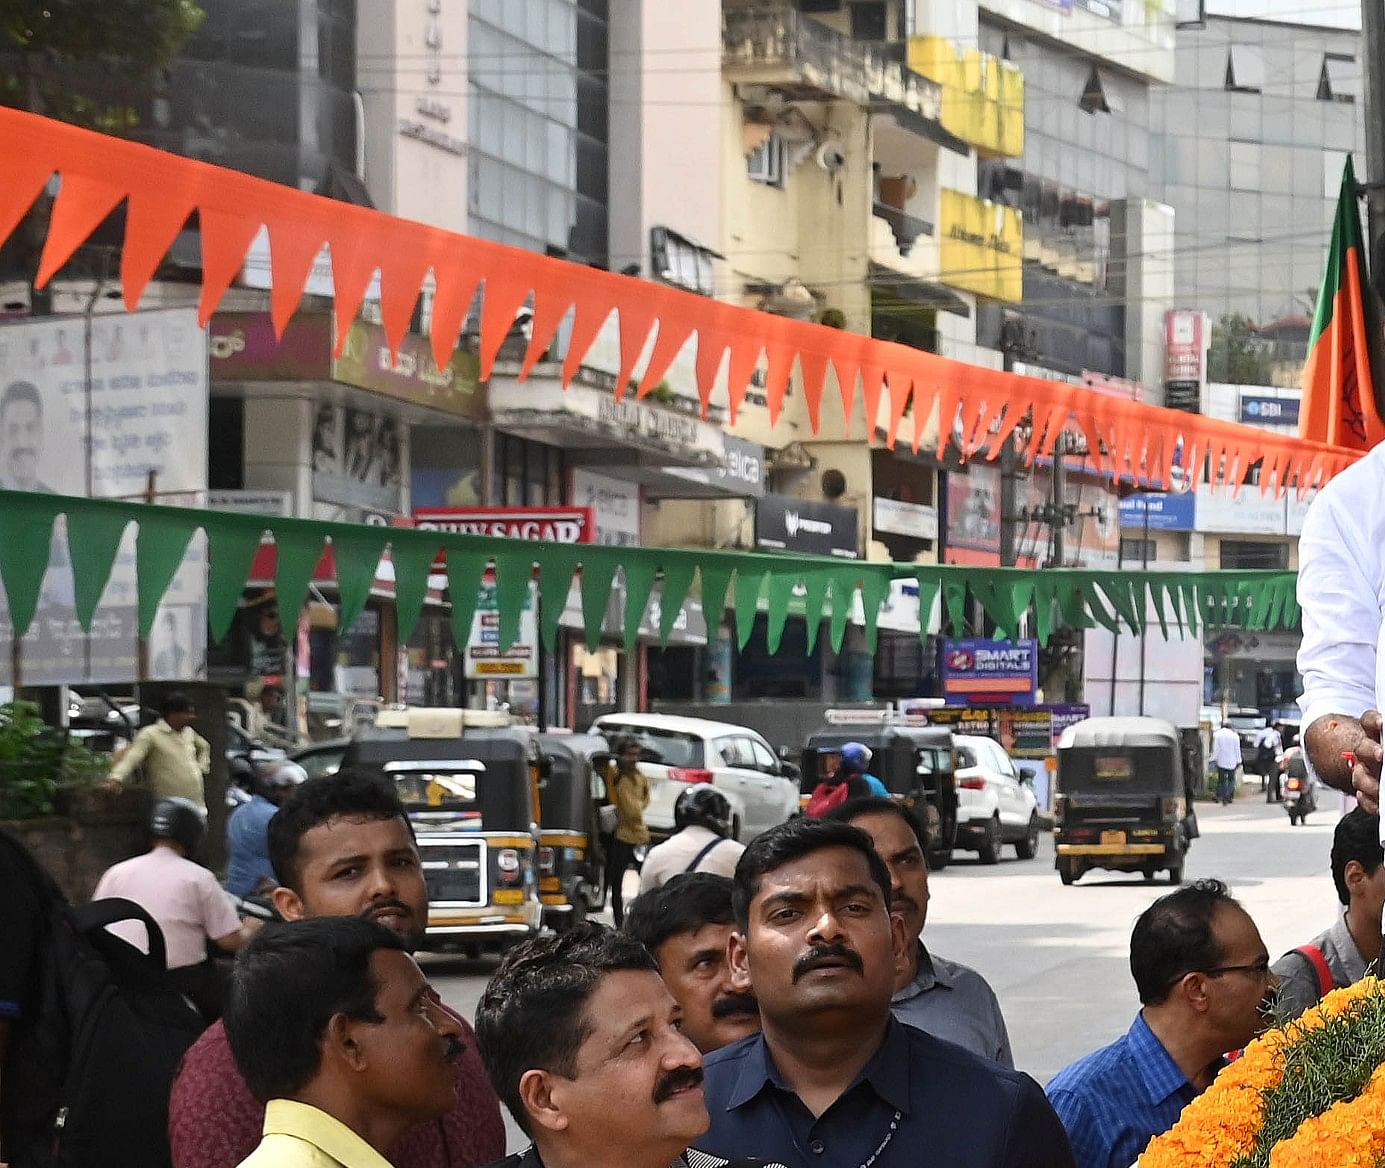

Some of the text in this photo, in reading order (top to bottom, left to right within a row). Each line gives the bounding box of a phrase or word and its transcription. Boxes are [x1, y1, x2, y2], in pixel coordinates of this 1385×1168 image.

[1260, 402, 1282, 417] SBI
[975, 649, 1031, 660] SMART
[975, 660, 1031, 671] DIGITALS
